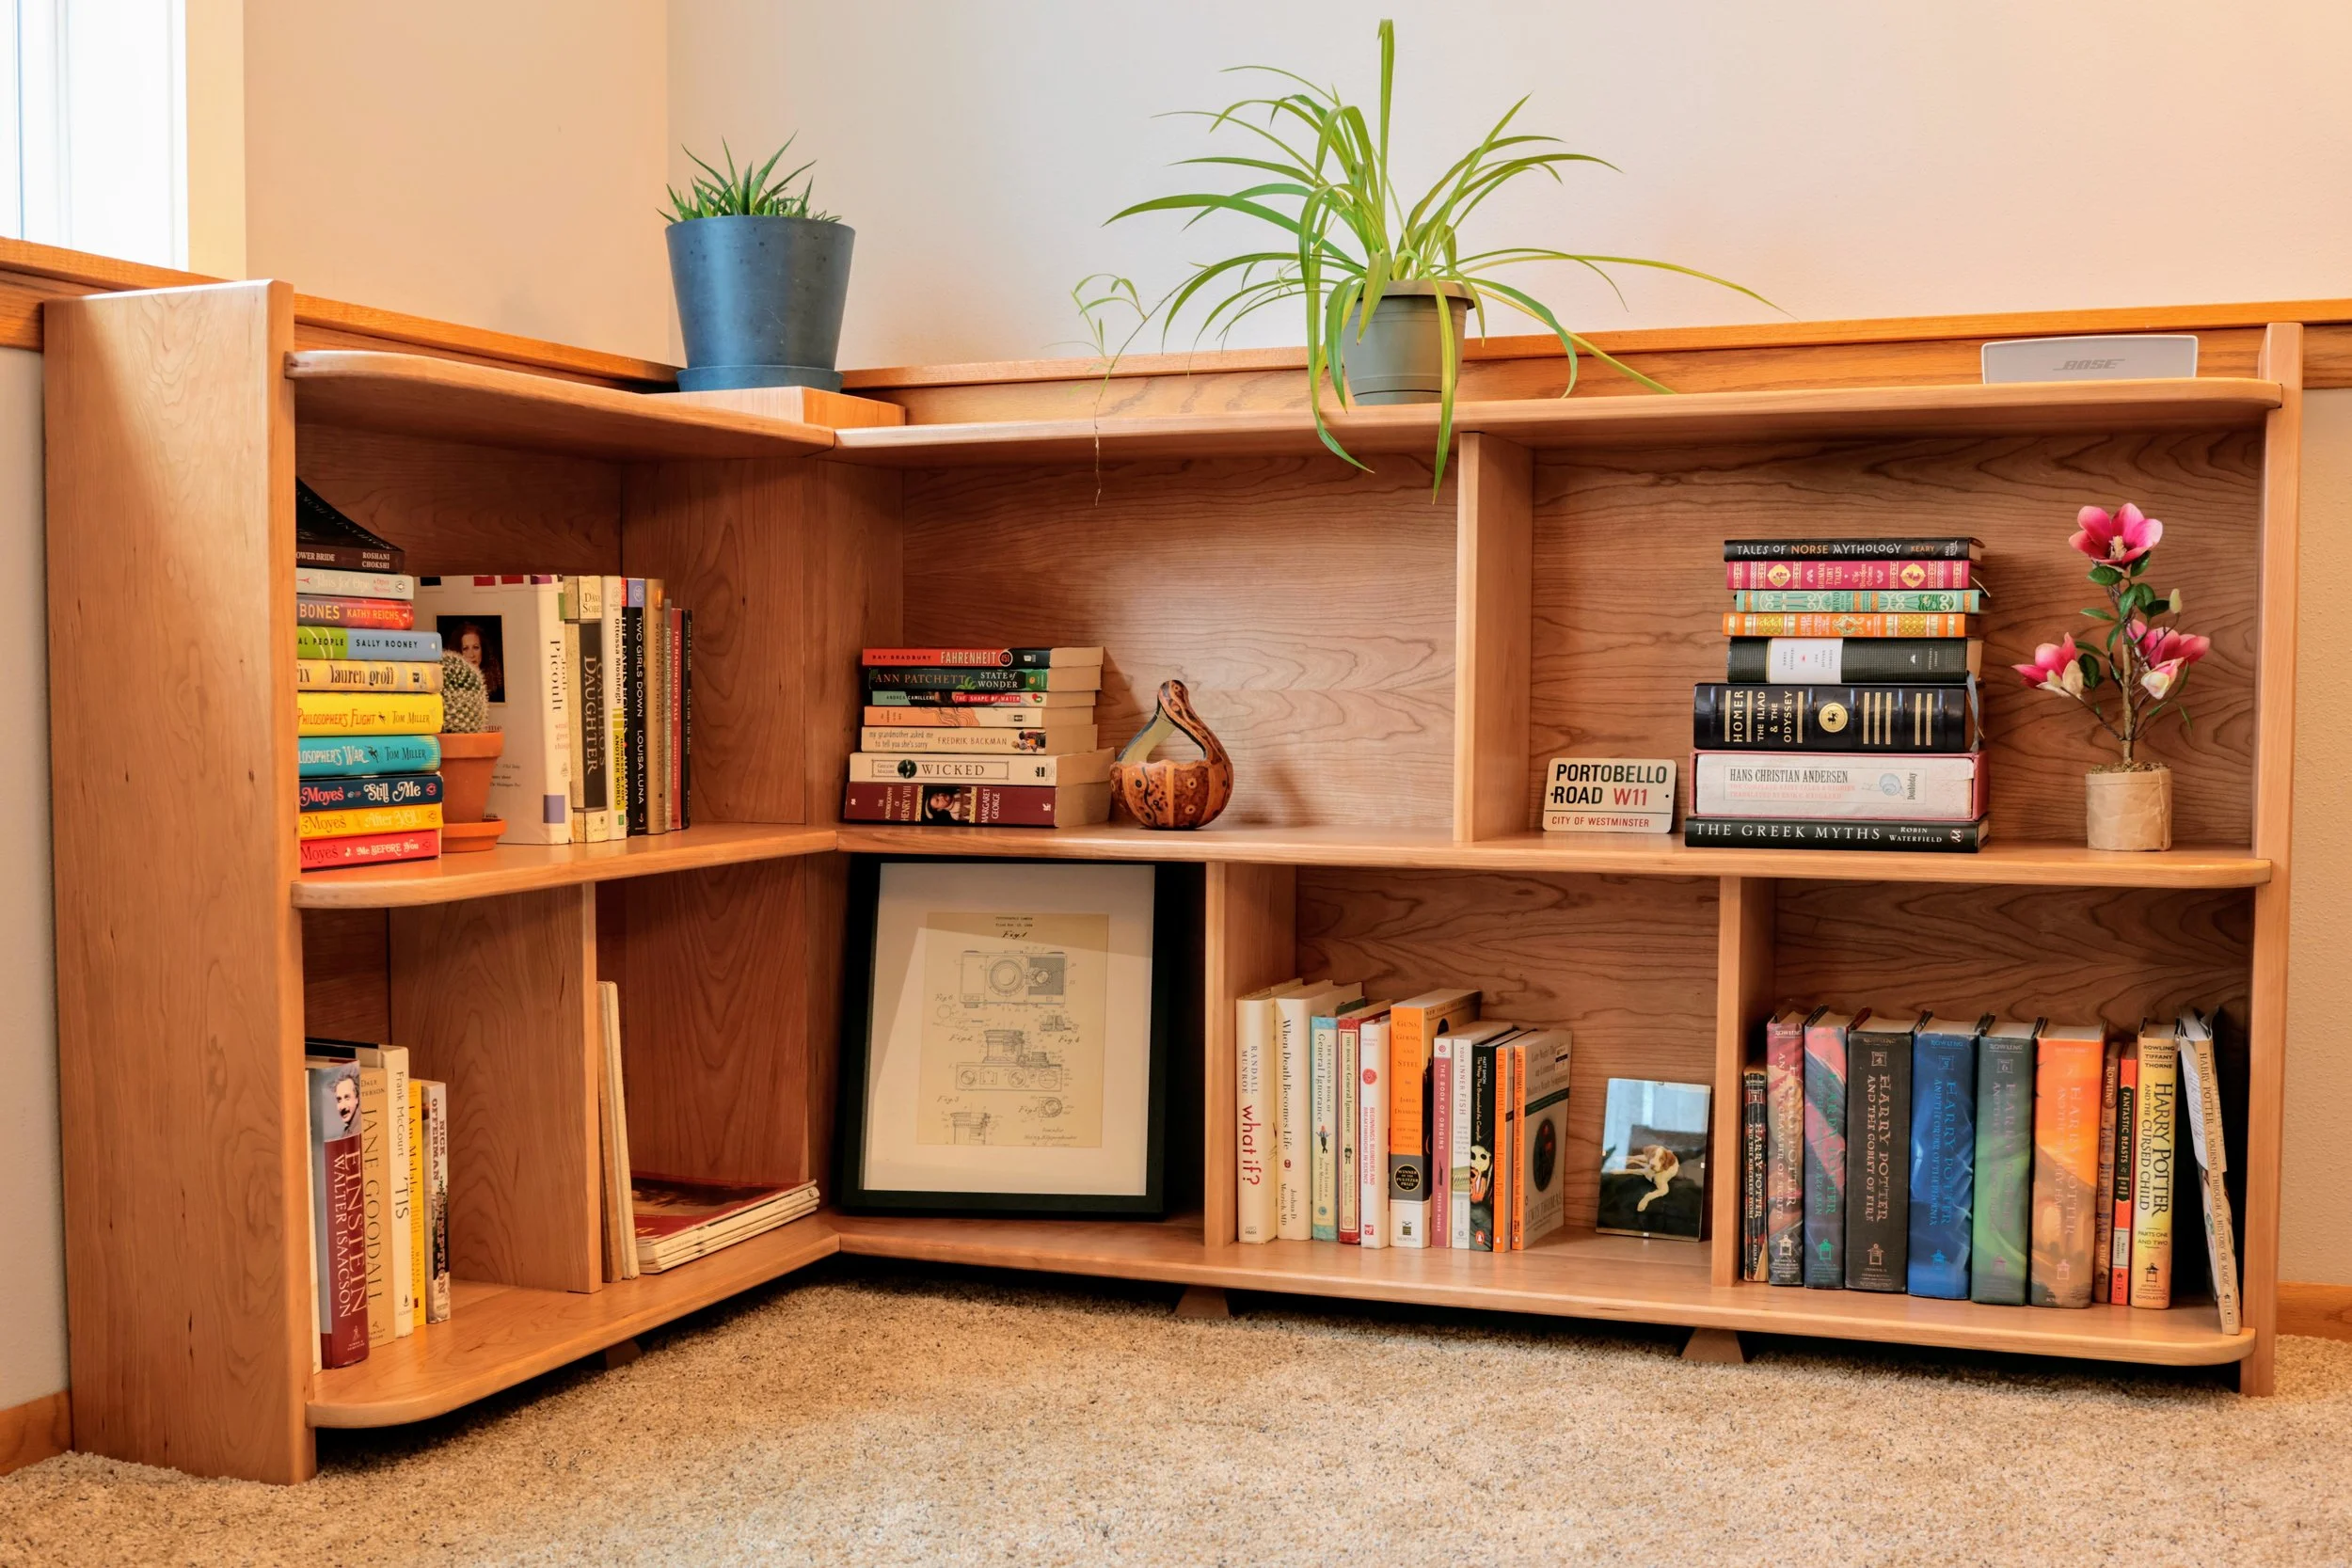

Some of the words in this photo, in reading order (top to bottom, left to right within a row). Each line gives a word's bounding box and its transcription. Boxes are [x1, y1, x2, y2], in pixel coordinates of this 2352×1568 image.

[2053, 358, 2125, 371] BOSE
[362, 552, 390, 561] ROSHANI
[1737, 544, 1769, 555] TALES
[1772, 544, 1788, 555] OF
[1790, 543, 1829, 555] NORSE
[1832, 542, 1903, 555] MYTHOLOGY
[1910, 545, 1935, 553] KEARY
[1825, 566, 1834, 585] FAIRY
[1835, 565, 1843, 586] TALES
[299, 603, 340, 620] BONES
[346, 609, 372, 619] KATHY
[372, 610, 399, 621] REICHS
[356, 639, 380, 648] SALLY
[385, 640, 418, 649] ROONEY
[941, 651, 997, 664] FAHRENHEIT
[1001, 655, 1010, 663] 451
[329, 664, 365, 685] lauren
[369, 667, 394, 687] groff
[550, 641, 564, 710] Picoult
[614, 657, 623, 705] Moshfegh
[875, 673, 899, 684] ANN
[904, 673, 968, 685] PATCHETT
[977, 680, 1019, 689] WONDER
[584, 656, 598, 775] DAUGHTER
[1733, 689, 1744, 743] HOMER
[1756, 690, 1766, 721] ILIAD
[1770, 703, 1779, 721] THE
[1784, 690, 1793, 744] ODYSSEY
[970, 737, 1008, 746] BACKMAN
[1756, 721, 1765, 742] THE
[1770, 724, 1778, 733] &
[384, 746, 399, 761] TOM
[402, 747, 426, 761] MILLER
[921, 764, 985, 776] WICKED
[1555, 763, 1668, 784] PORTOBELLO
[1729, 768, 1753, 783] HANS
[1755, 768, 1801, 784] CHRISTIAN
[1803, 769, 1849, 784] ANDERSEN
[299, 786, 344, 807] Moyes
[363, 783, 389, 803] Still
[391, 781, 421, 801] Me
[903, 785, 913, 800] VIII
[991, 792, 1001, 819] GEORGE
[1553, 785, 1603, 805] ROAD
[1613, 786, 1647, 807] W11
[900, 800, 911, 822] HENRY
[980, 788, 991, 824] MARGARET
[301, 815, 346, 833] Moyes
[1551, 816, 1571, 826] CITY
[1574, 816, 1585, 827] OF
[1588, 816, 1650, 828] WESTMINSTER
[1695, 823, 1732, 836] THE
[1741, 824, 1806, 838] GREEK
[1815, 826, 1881, 840] MYTHS
[1900, 826, 1928, 834] ROBIN
[356, 847, 370, 856] Me
[370, 843, 402, 856] BEFORE
[403, 839, 419, 852] You
[1889, 834, 1943, 843] WATERFIELD
[300, 845, 339, 863] Moyes
[1281, 1019, 1292, 1050] When
[1281, 1051, 1293, 1081] Death
[1317, 1033, 1326, 1072] General
[1250, 1045, 1259, 1095] RANDALL
[2199, 1053, 2208, 1084] HARRY
[396, 1070, 405, 1101] Frank
[2105, 1066, 2116, 1103] ROWLING
[1281, 1083, 1293, 1127] Becomes
[1316, 1075, 1325, 1122] Ignorance
[1438, 1105, 1445, 1115] OF
[1458, 1093, 1467, 1116] FISH
[1879, 1074, 1891, 1147] HARRY
[1943, 1081, 1957, 1150] HARRY
[2121, 1091, 2130, 1134] FANTASTIC
[2153, 1082, 2173, 1144] HARRY
[361, 1109, 379, 1170] JANE
[397, 1106, 405, 1158] McCourt
[431, 1098, 440, 1181] OFFERMAN
[1241, 1104, 1262, 1155] what
[1282, 1130, 1293, 1150] Life
[2140, 1119, 2152, 1167] CURSED
[1753, 1122, 1762, 1169] HARRY
[1867, 1133, 1875, 1175] GOBLET
[2120, 1136, 2129, 1164] BEASTS
[2208, 1137, 2218, 1171] JOURNEY
[1242, 1160, 1263, 1185] if?
[1867, 1177, 1875, 1192] OF
[2152, 1147, 2171, 1217] POTTER
[333, 1154, 348, 1224] WALTER
[395, 1176, 409, 1220] 'TIS
[1754, 1172, 1762, 1219] POTTER
[1877, 1151, 1890, 1222] POTTER
[1940, 1157, 1954, 1225] POTTER
[2138, 1169, 2151, 1212] CHILD
[2212, 1175, 2221, 1211] THROUGH
[1866, 1196, 1874, 1222] FIRE
[344, 1149, 367, 1313] EINSTEIN
[364, 1180, 383, 1304] GOODALL
[2217, 1220, 2226, 1249] HISTORY
[2220, 1252, 2227, 1261] OF
[336, 1230, 351, 1318] ISAACSON
[2221, 1264, 2231, 1288] MAGIC
